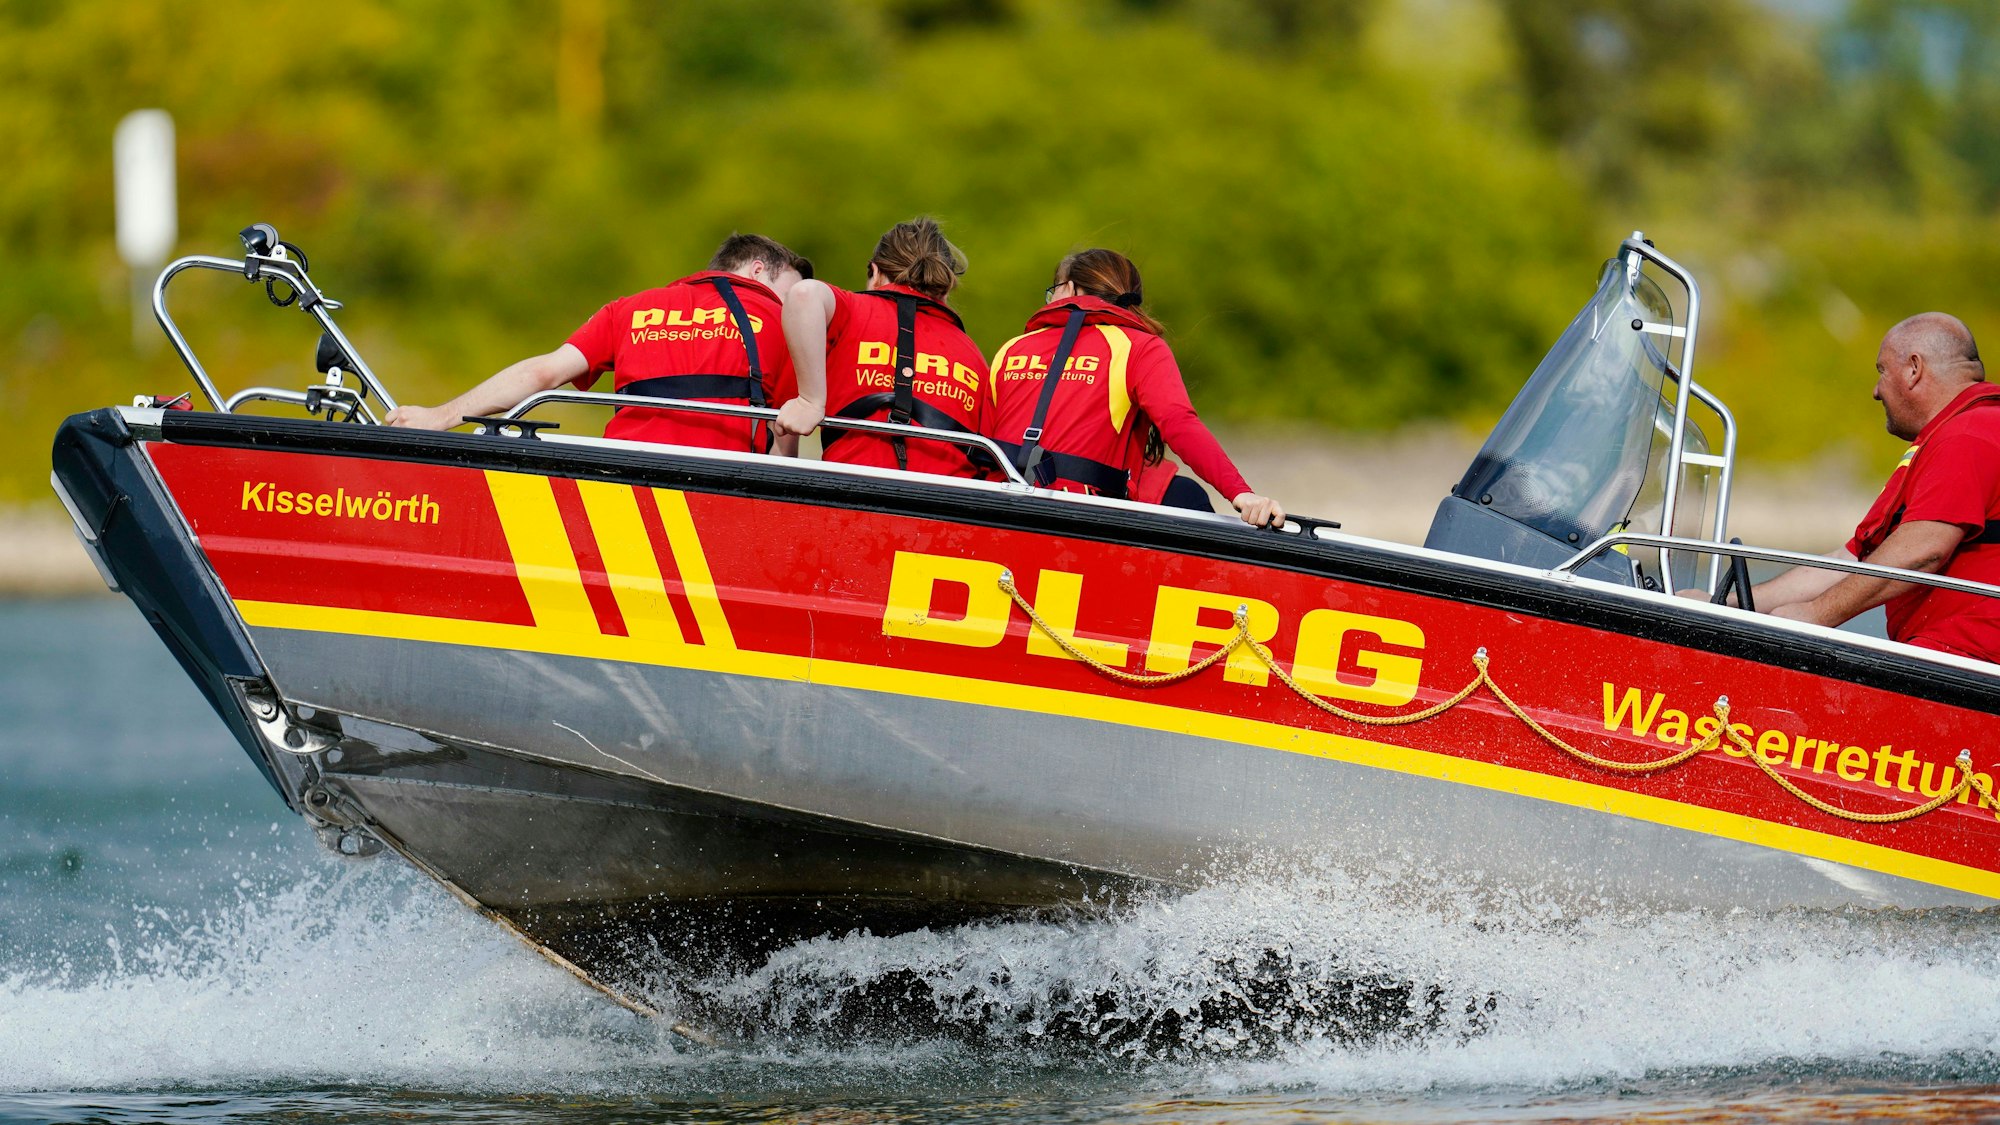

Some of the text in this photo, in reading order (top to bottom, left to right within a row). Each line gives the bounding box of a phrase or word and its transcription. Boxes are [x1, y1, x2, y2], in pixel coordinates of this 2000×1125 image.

[631, 325, 746, 349] Wasserrettun
[857, 341, 979, 392] DRG
[1004, 371, 1095, 384] Wasserttung
[241, 481, 440, 524] Kisselwörth
[882, 550, 1425, 707] DLRG
[1602, 682, 2000, 822] Wasserrettun
